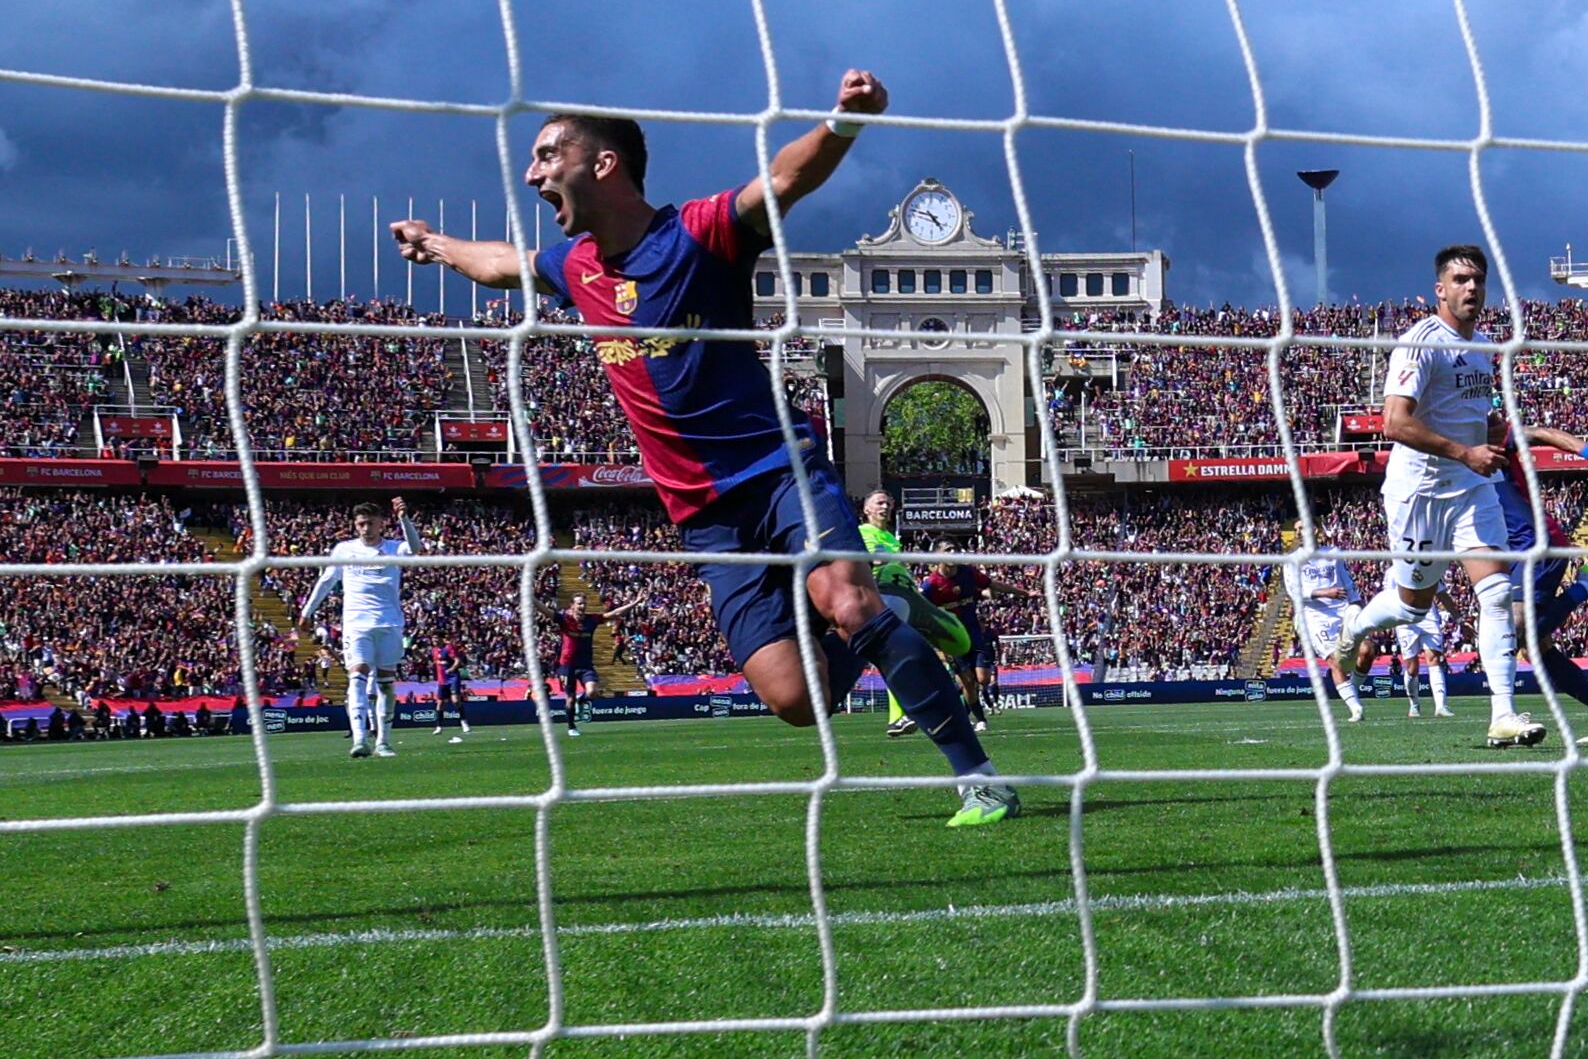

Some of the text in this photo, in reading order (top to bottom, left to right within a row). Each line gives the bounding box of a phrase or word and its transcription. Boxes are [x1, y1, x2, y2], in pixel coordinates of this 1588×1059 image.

[52, 468, 102, 477] BARCELONA
[1201, 464, 1255, 476] ESTRELLA
[393, 472, 440, 480] BARCELONA
[906, 510, 973, 520] BARCELONA
[1402, 537, 1434, 566] 35
[1215, 687, 1245, 697] Ninguna
[1266, 686, 1285, 694] fuera
[1359, 684, 1373, 692] Cap
[1127, 690, 1152, 698] offside
[625, 706, 647, 715] juego
[694, 704, 710, 713] Cap
[287, 715, 330, 724] fora de joc
[415, 711, 435, 719] child
